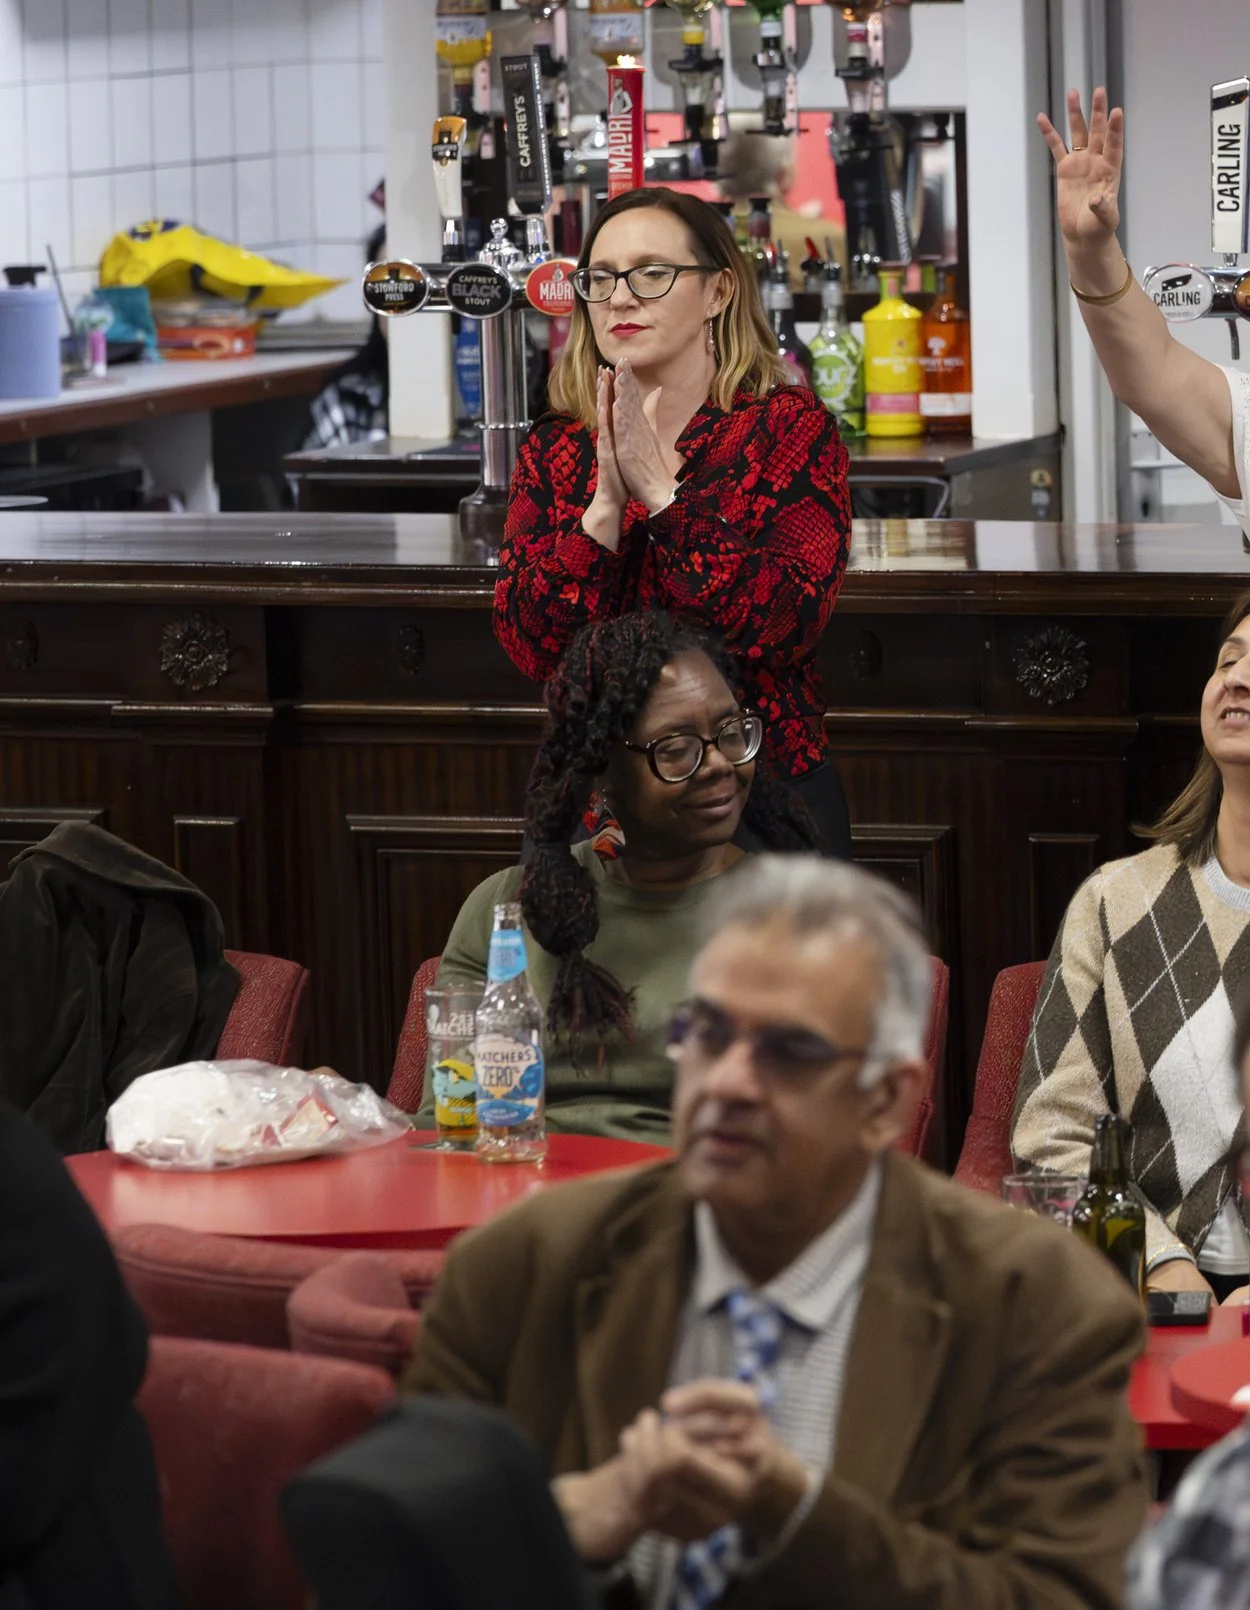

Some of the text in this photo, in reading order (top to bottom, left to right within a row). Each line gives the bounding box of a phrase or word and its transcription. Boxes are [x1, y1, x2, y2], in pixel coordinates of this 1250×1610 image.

[1216, 123, 1241, 213] CARLING
[374, 281, 415, 294] STOWFORD
[452, 282, 502, 299] BLACK
[464, 297, 491, 307] STOUT
[1153, 291, 1201, 307] CARLING
